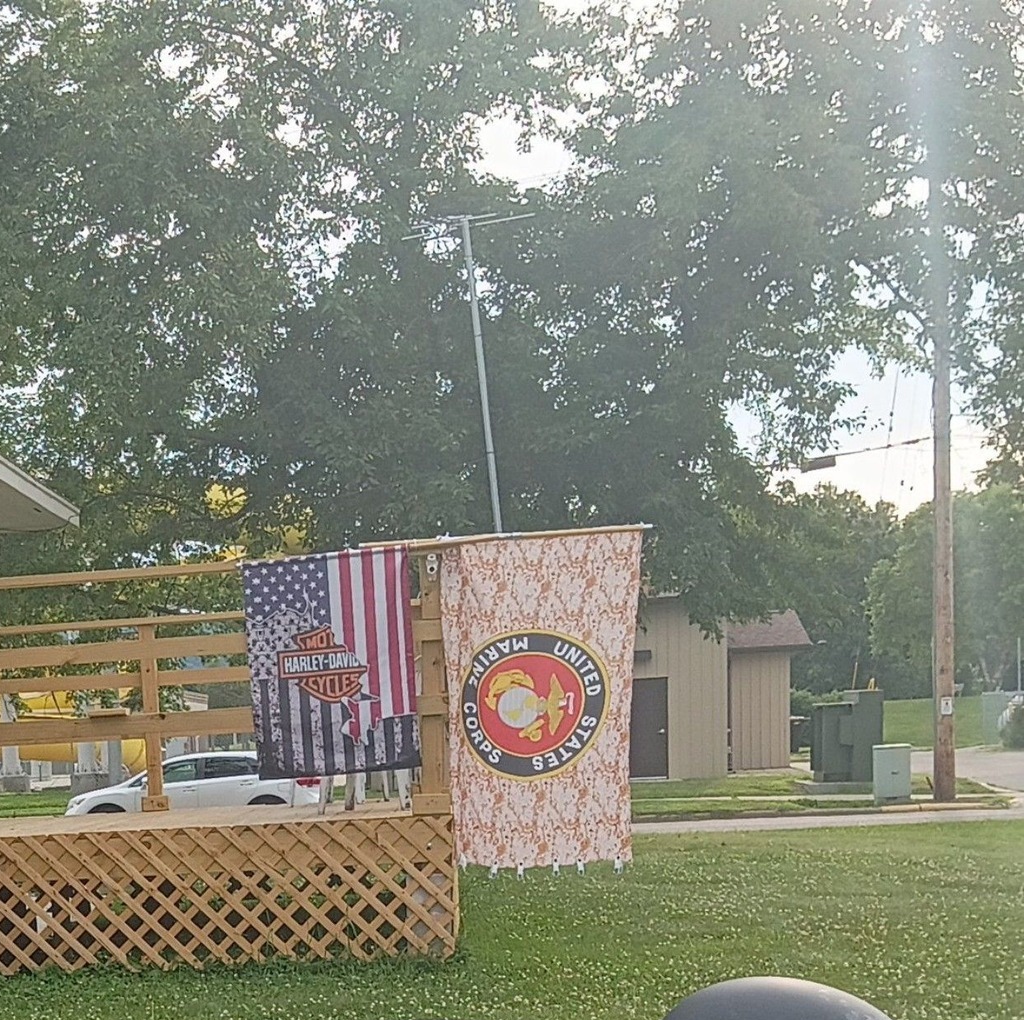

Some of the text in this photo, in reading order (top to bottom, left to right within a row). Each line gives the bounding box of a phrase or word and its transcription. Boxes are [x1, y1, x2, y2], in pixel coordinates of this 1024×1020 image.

[308, 673, 360, 697] CYCLES
[464, 637, 528, 763] MARINE CORPS
[532, 641, 601, 770] UNITED STATES
